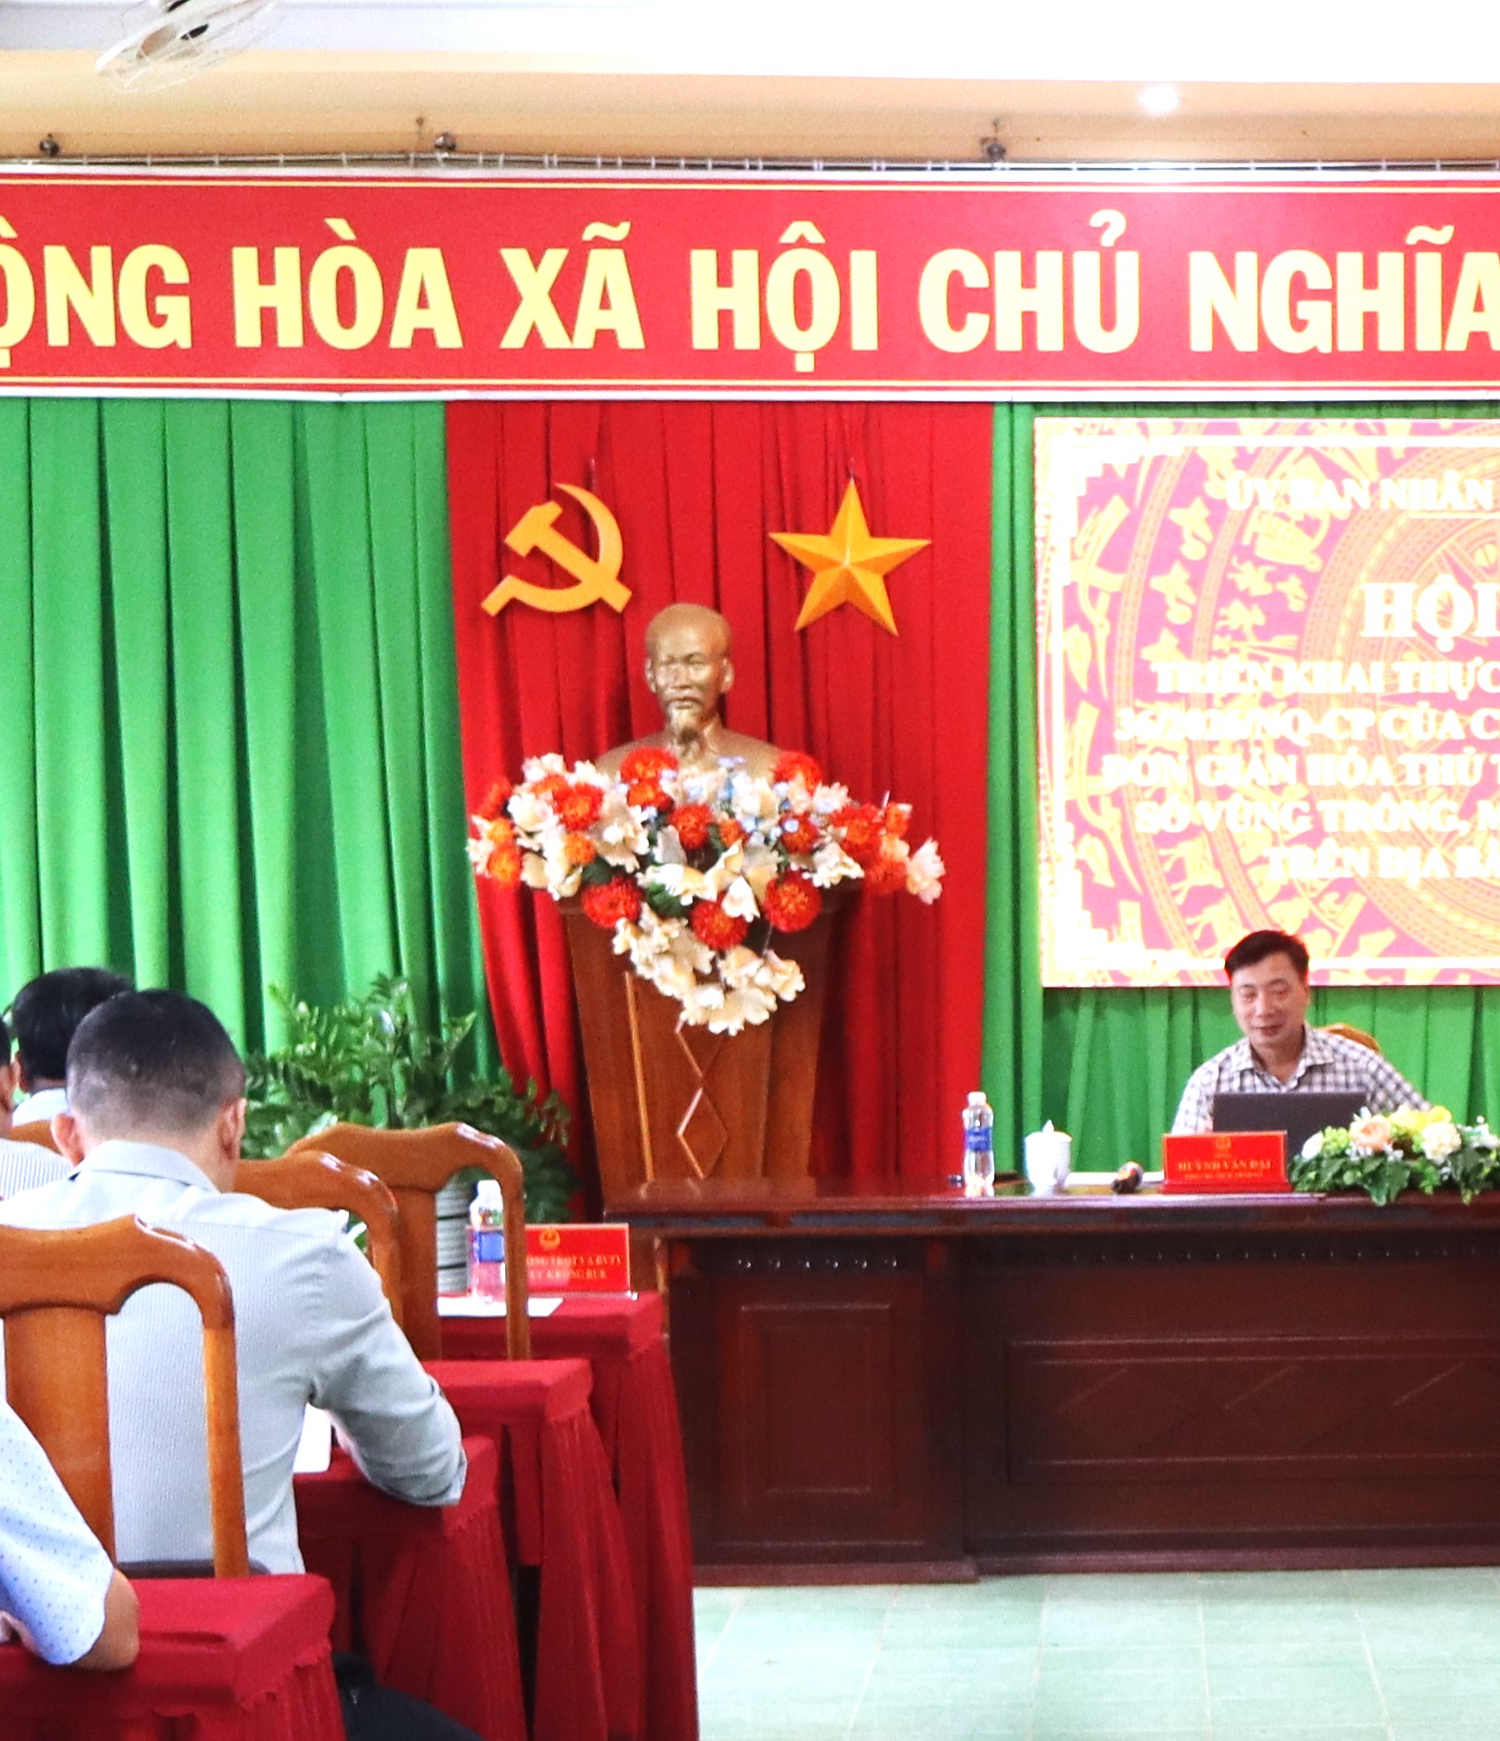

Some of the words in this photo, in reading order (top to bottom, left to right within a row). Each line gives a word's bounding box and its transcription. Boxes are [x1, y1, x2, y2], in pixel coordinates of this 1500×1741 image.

[232, 218, 463, 349] HÒA
[500, 221, 645, 350] XÃ
[690, 221, 878, 372] HỘI
[918, 210, 1143, 354] CHỦ
[1285, 477, 1369, 511] BAN
[1381, 470, 1492, 511] NHÂN
[1360, 574, 1500, 653] HỘI
[1282, 661, 1384, 694] KHAI
[1380, 702, 1465, 741] CỦA
[1305, 746, 1395, 787] HÓA
[1399, 747, 1483, 787] THỦ
[1263, 838, 1369, 879] TRÊN
[1379, 847, 1450, 886] ĐỊA
